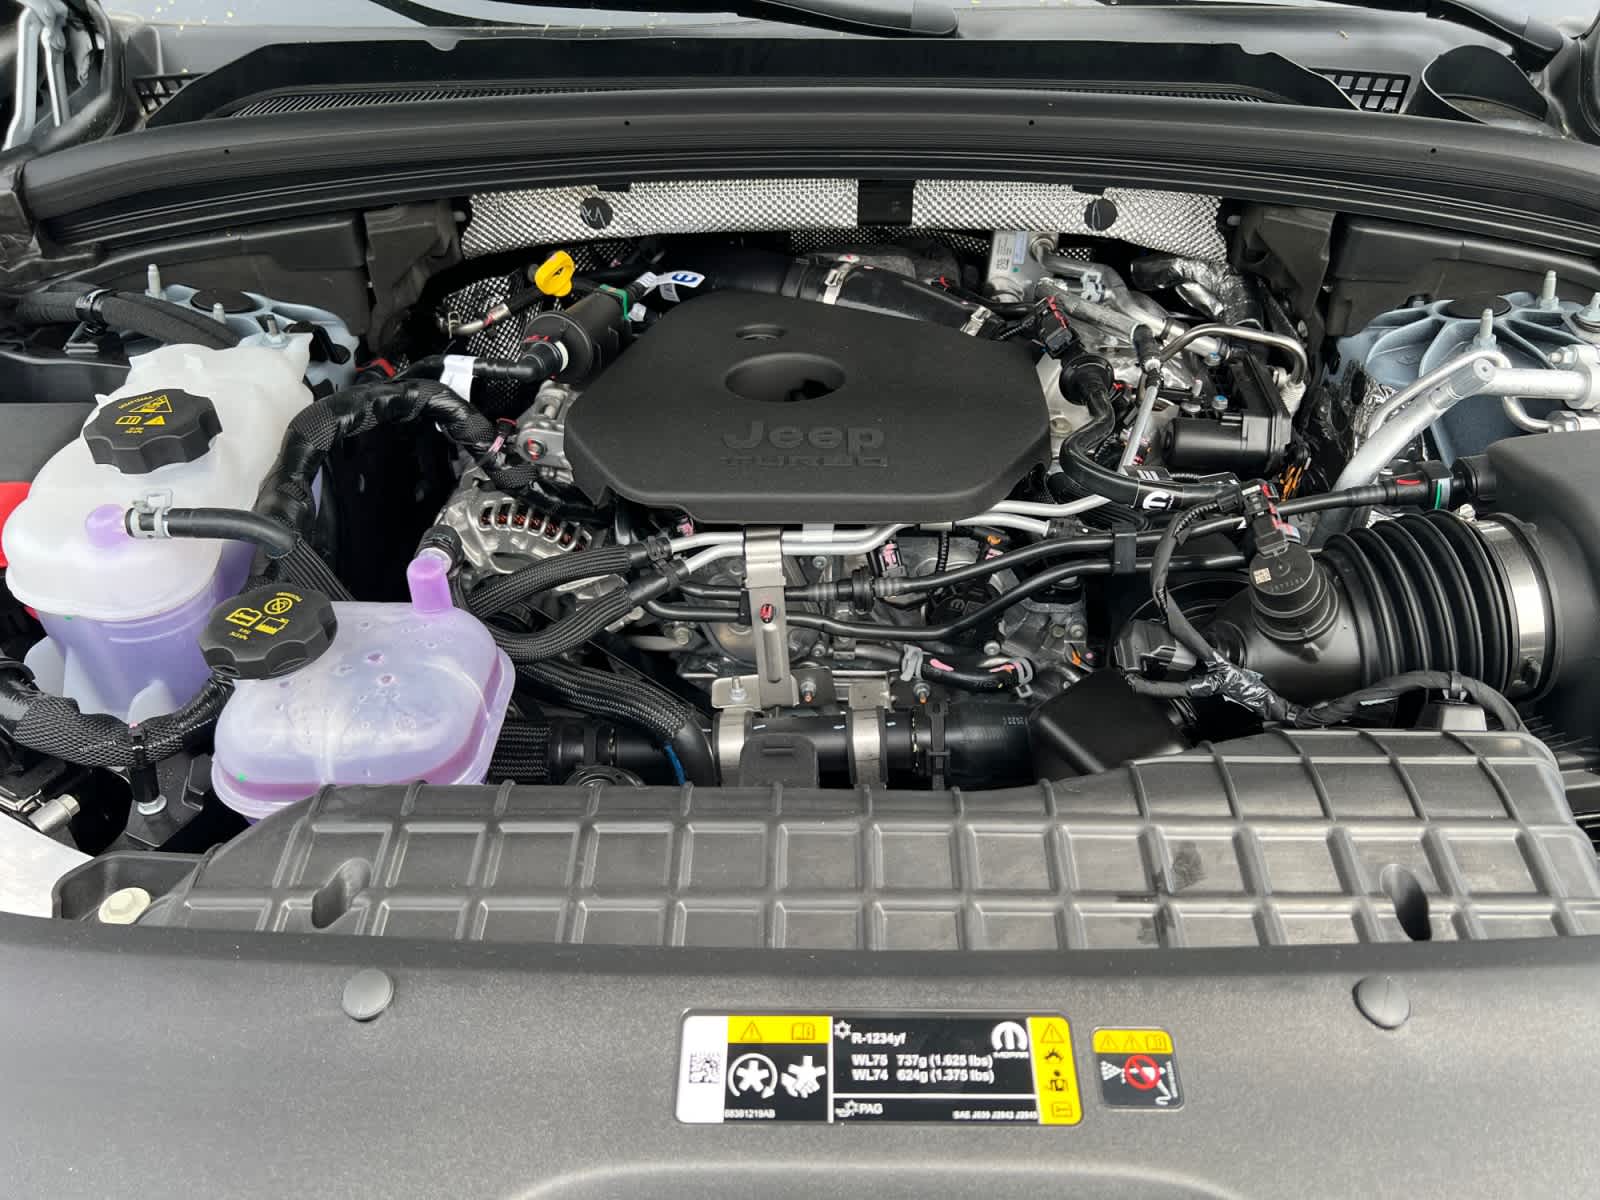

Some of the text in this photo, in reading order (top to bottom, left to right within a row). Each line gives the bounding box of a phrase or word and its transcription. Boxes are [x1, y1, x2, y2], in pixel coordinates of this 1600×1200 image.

[721, 421, 886, 455] Jeep
[851, 1032, 907, 1047] R-1234yf
[851, 1054, 888, 1066] WL75
[896, 1054, 927, 1069] 737g
[968, 1054, 994, 1069] lbs)
[851, 1069, 995, 1084] WL74 624g (1.375 lbs)
[858, 1103, 884, 1115] PAG
